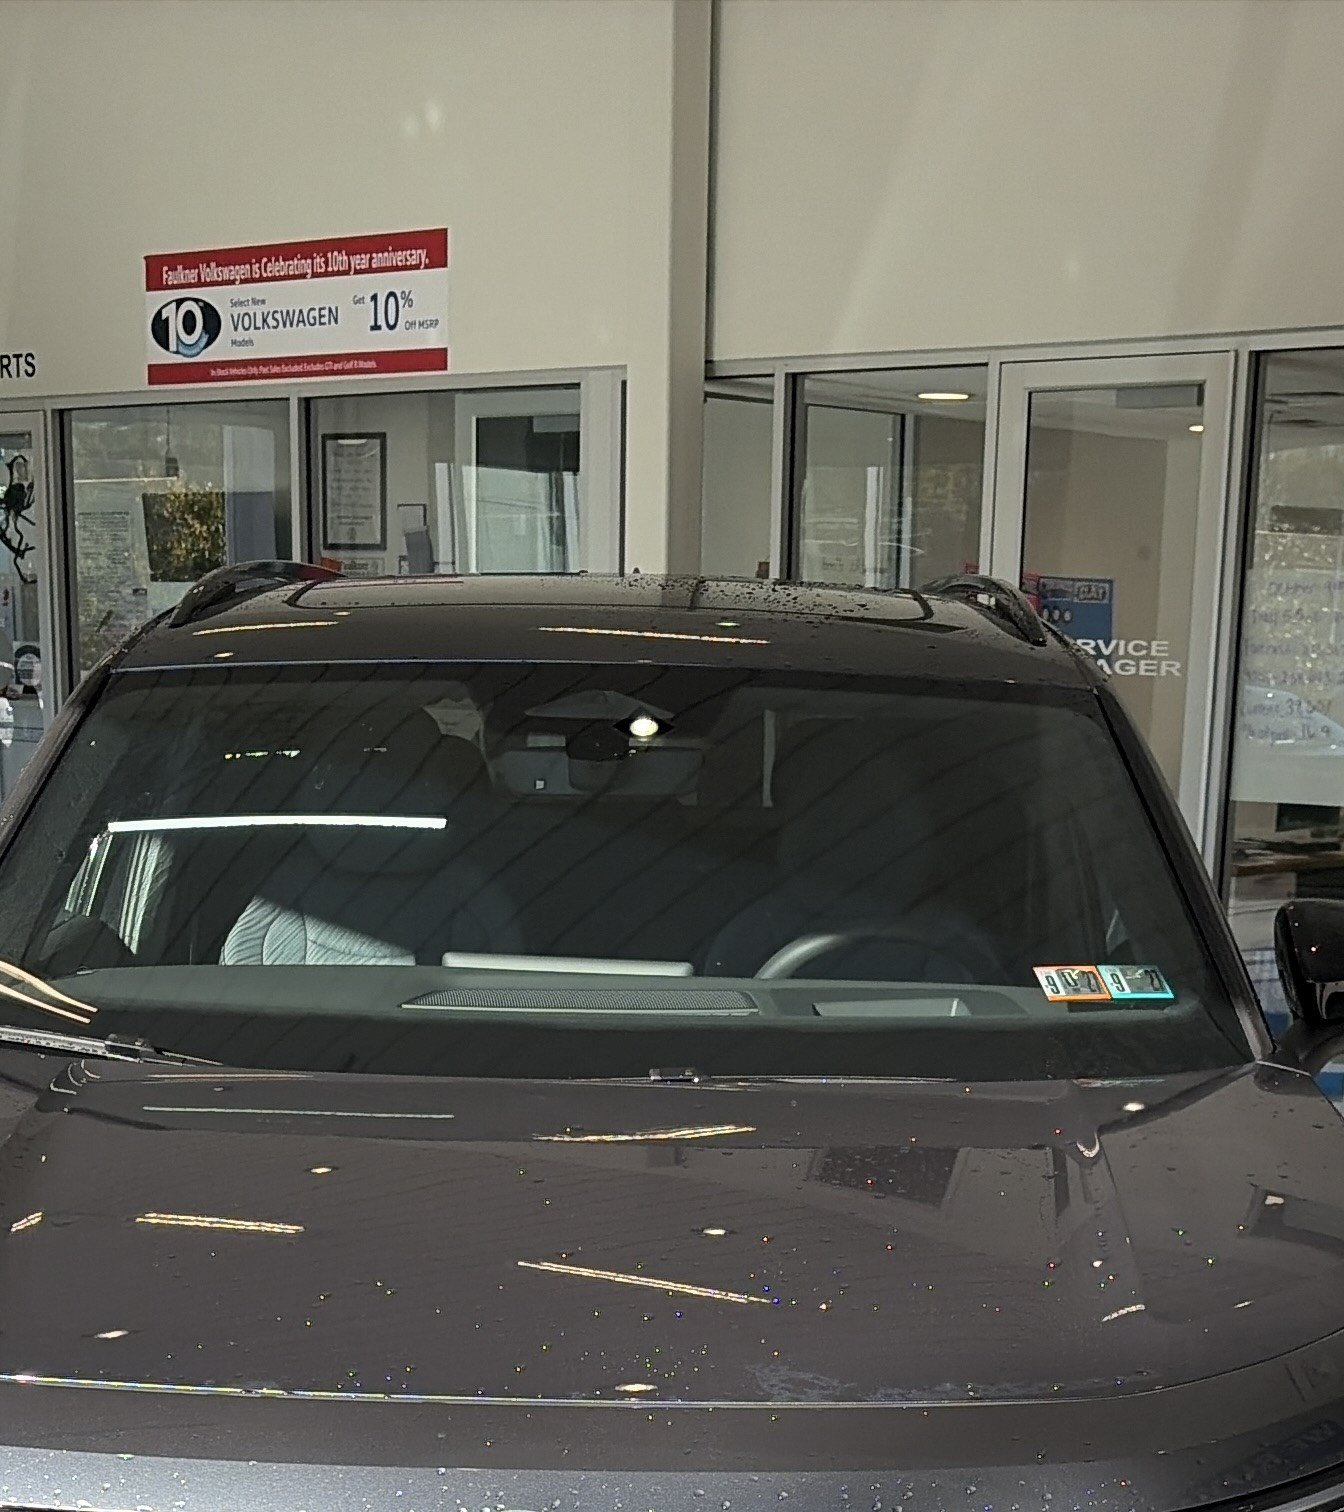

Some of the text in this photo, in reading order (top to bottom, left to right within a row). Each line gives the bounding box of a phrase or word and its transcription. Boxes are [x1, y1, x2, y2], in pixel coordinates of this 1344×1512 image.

[162, 264, 199, 285] Faulkner
[199, 261, 251, 284] Volkswagen
[252, 258, 260, 278] is
[261, 253, 312, 279] Celebrating
[327, 250, 349, 272] 10th
[350, 252, 371, 275] year
[371, 245, 430, 269] anniversary.
[229, 297, 266, 308] Select New
[352, 294, 365, 305] Get
[230, 305, 339, 332] VOLKSWAGEN
[417, 318, 440, 330] MSRP
[230, 337, 255, 348] Models
[1076, 638, 1170, 657] RVICE
[1096, 658, 1182, 677] AGER
[1044, 974, 1060, 995] 9
[1110, 972, 1126, 993] 9
